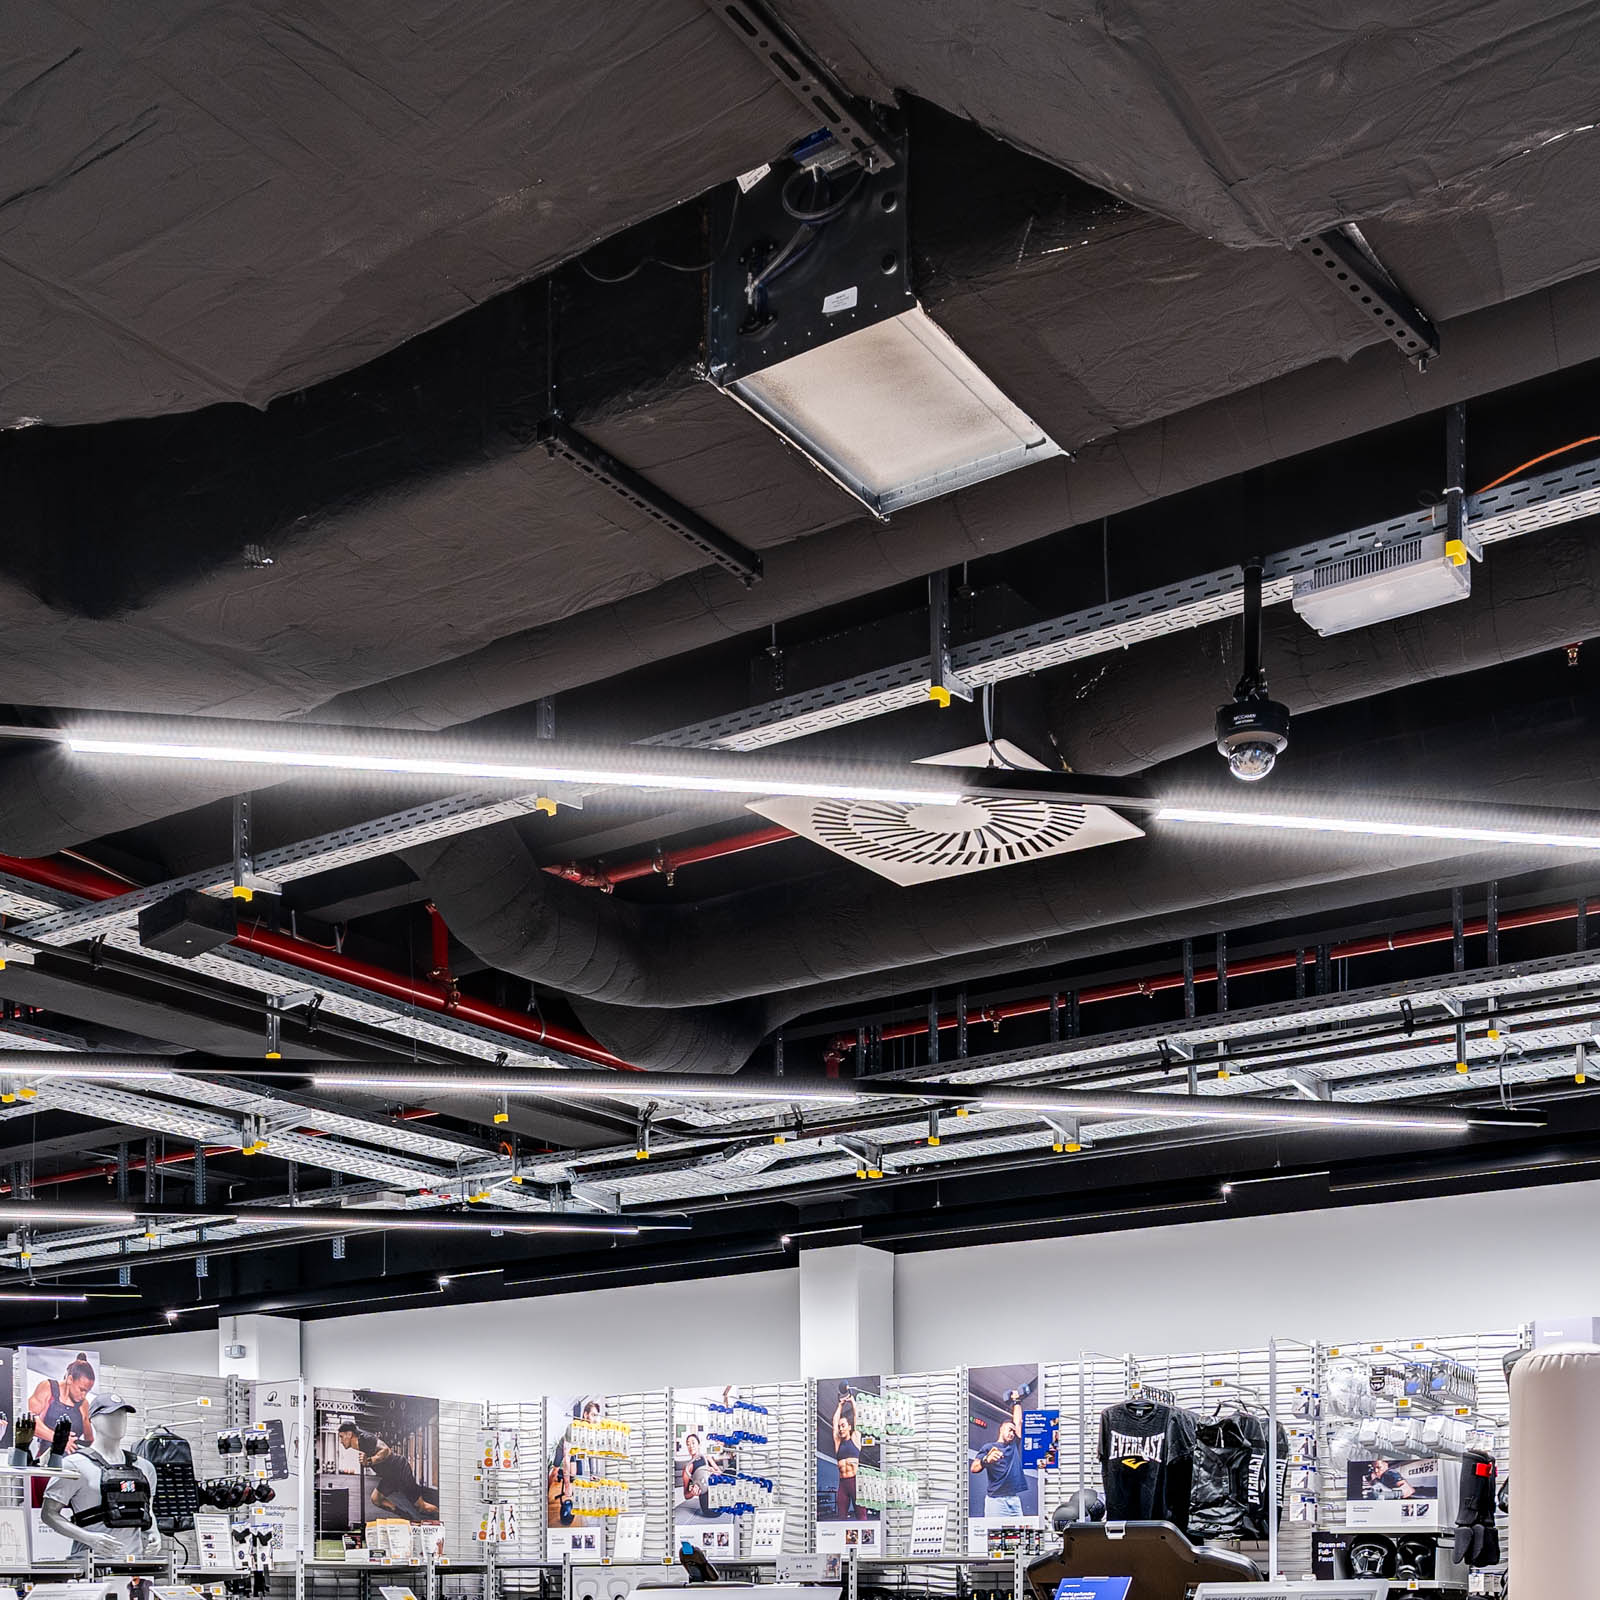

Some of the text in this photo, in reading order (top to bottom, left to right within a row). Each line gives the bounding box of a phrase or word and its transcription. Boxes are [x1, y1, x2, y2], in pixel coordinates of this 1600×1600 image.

[1109, 1430, 1166, 1463] EVERLAST
[1248, 1453, 1266, 1505] EVERLAST
[1408, 1465, 1434, 1476] CHAMPS
